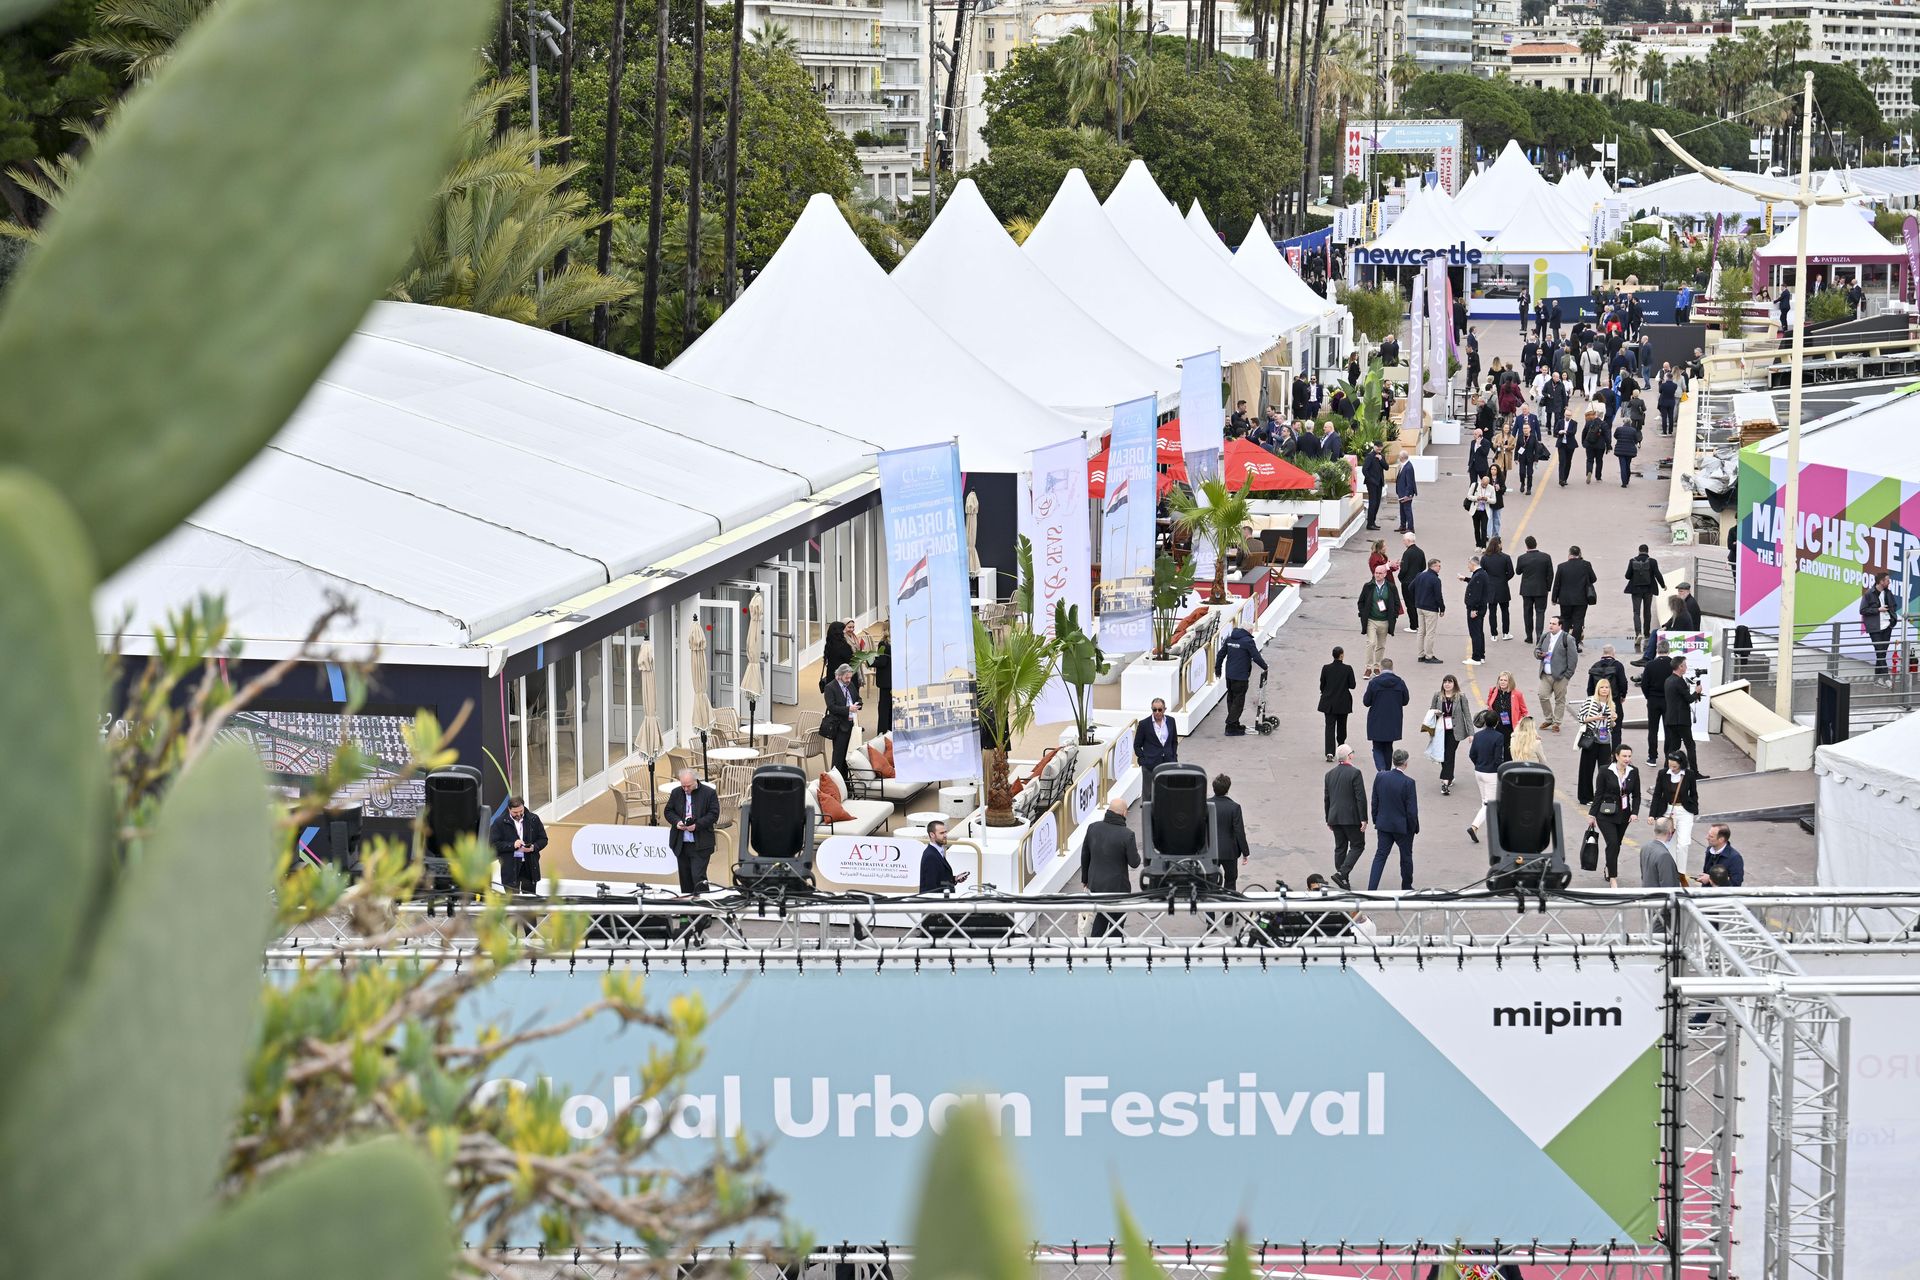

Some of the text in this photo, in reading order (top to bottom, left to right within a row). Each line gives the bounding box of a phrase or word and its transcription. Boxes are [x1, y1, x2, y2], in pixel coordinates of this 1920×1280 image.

[1354, 240, 1482, 265] newcastle
[1752, 502, 1920, 577] MANCHESTER
[1757, 548, 1774, 566] THE
[1800, 557, 1841, 582] GROWTH
[1843, 567, 1912, 602] OPPORNITY
[1668, 640, 1709, 649] ANCHESTER
[1079, 778, 1095, 812] Egypt
[592, 842, 667, 859] TOWNS & SEAS
[1493, 1001, 1622, 1034] mipim
[1064, 1072, 1386, 1138] Festival
